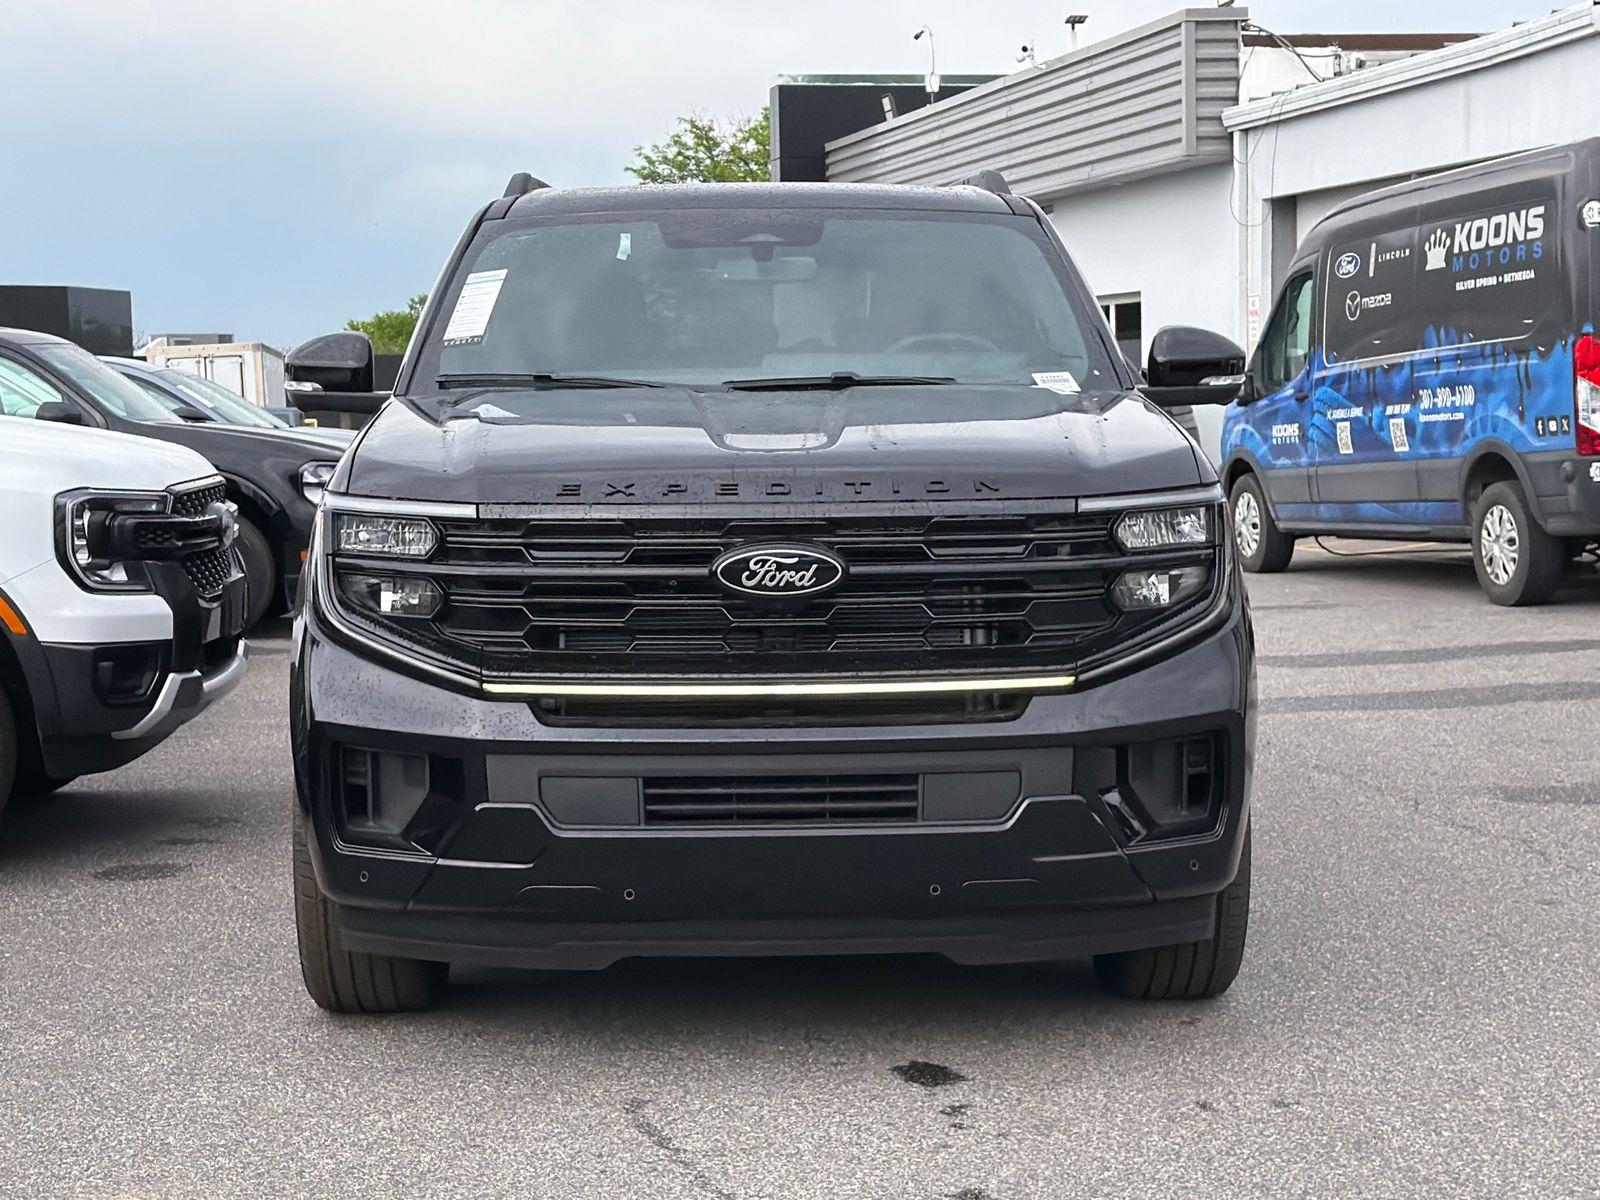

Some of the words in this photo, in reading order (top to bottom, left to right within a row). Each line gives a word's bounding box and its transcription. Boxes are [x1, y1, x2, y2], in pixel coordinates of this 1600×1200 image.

[1453, 205, 1545, 254] KOONS
[1378, 248, 1410, 262] LINCOLN
[1452, 241, 1543, 272] MOTORS
[1272, 423, 1299, 437] KOONS
[556, 480, 1001, 498] EXPEDITION
[741, 555, 818, 588] Ford
